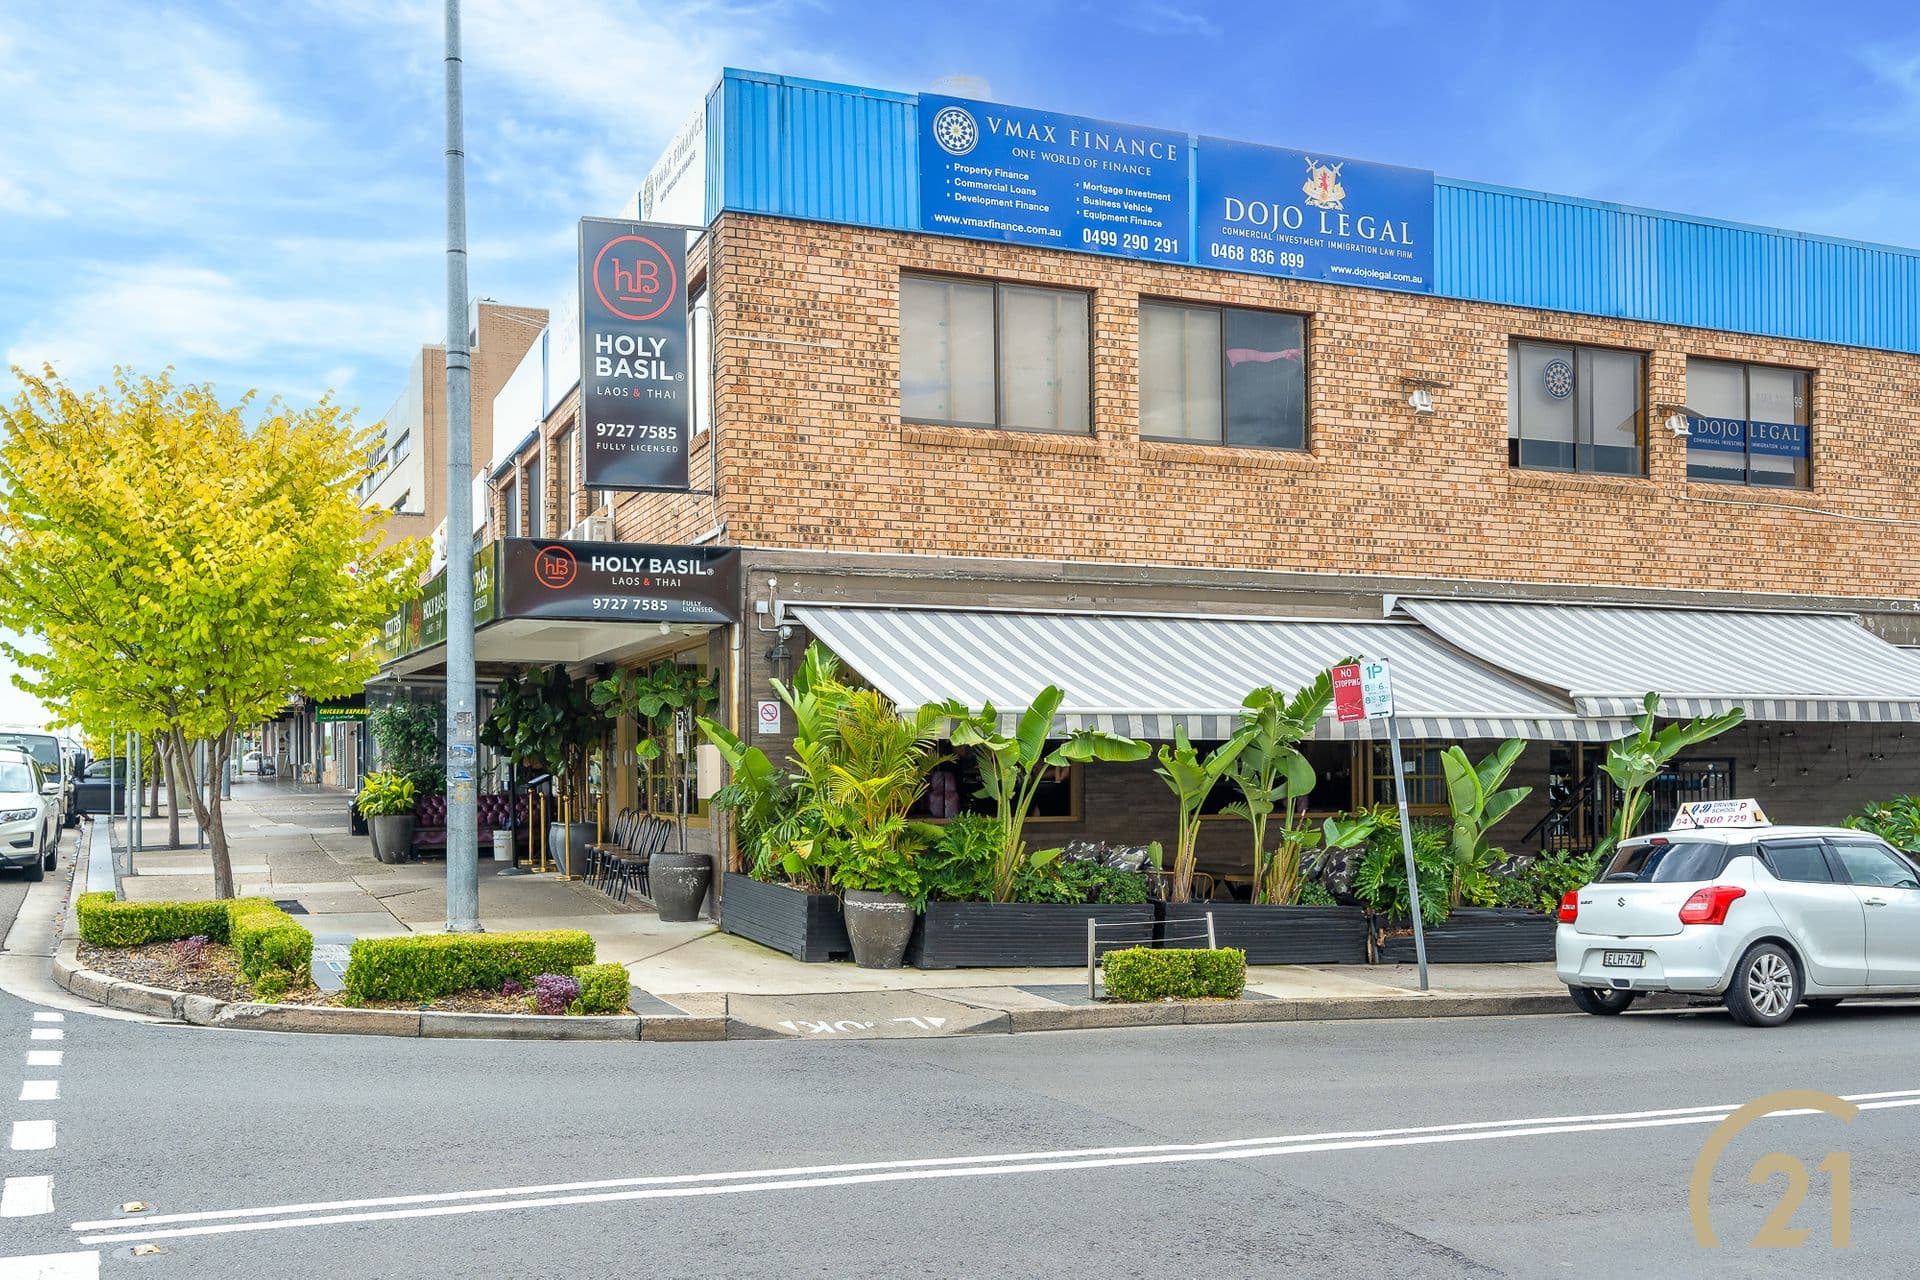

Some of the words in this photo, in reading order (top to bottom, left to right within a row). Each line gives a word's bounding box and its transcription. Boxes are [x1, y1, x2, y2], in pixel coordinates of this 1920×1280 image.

[986, 116, 1056, 143] VMAX
[1070, 130, 1176, 160] FINANCE
[1012, 148, 1036, 159] ONE
[1041, 152, 1080, 166] WORLD
[1084, 159, 1098, 168] OF
[1103, 161, 1151, 176] FINANCE
[954, 164, 992, 177] Property
[995, 169, 1029, 180] Finance
[954, 178, 1008, 192] Commercial
[1010, 185, 1036, 196] Loans
[1083, 182, 1123, 196] Mortgage
[1125, 188, 1171, 201] Investment
[954, 193, 1012, 208] Development
[1016, 200, 1049, 212] Finance
[1083, 196, 1120, 208] Business
[1123, 201, 1152, 213] Vehicle
[934, 214, 1061, 236] www.vmaxfinance.com.au
[1083, 210, 1128, 222] Equipment
[1130, 216, 1162, 228] Finance
[1224, 197, 1302, 233] DOJO
[1320, 211, 1413, 244] LEGAL
[1083, 228, 1117, 246] 0499
[1123, 234, 1148, 250] 290
[1154, 238, 1178, 254] 291
[1222, 227, 1272, 240] COMMERCIAL
[1276, 234, 1324, 247] INVESTMENT
[1328, 241, 1377, 254] IMMIGRATION
[1380, 248, 1394, 256] LAW
[1396, 250, 1412, 258] FIRM
[1211, 242, 1244, 260] 0468
[1250, 248, 1274, 264] 836
[1280, 252, 1304, 268] 899
[1331, 265, 1422, 284] www.dojolegal.com.au
[595, 333, 667, 358] HOLY
[597, 386, 628, 397] LAOS
[632, 389, 640, 398] &
[647, 389, 676, 400] THAI
[596, 423, 634, 438] 9727
[638, 426, 676, 440] 7585
[1698, 420, 1739, 438] DOJO
[1750, 424, 1800, 440] LEGAL
[596, 443, 626, 451] FULLY
[630, 444, 678, 453] LICENSED
[591, 556, 647, 573] HOLY
[612, 577, 640, 586] LAOS
[656, 578, 681, 587] THAI
[592, 599, 627, 610] 9727
[633, 600, 668, 611] 7585
[1340, 668, 1352, 678] NO
[1366, 666, 1382, 679] 1P
[1335, 678, 1360, 688] STOPPING
[1754, 812, 1761, 822] L
